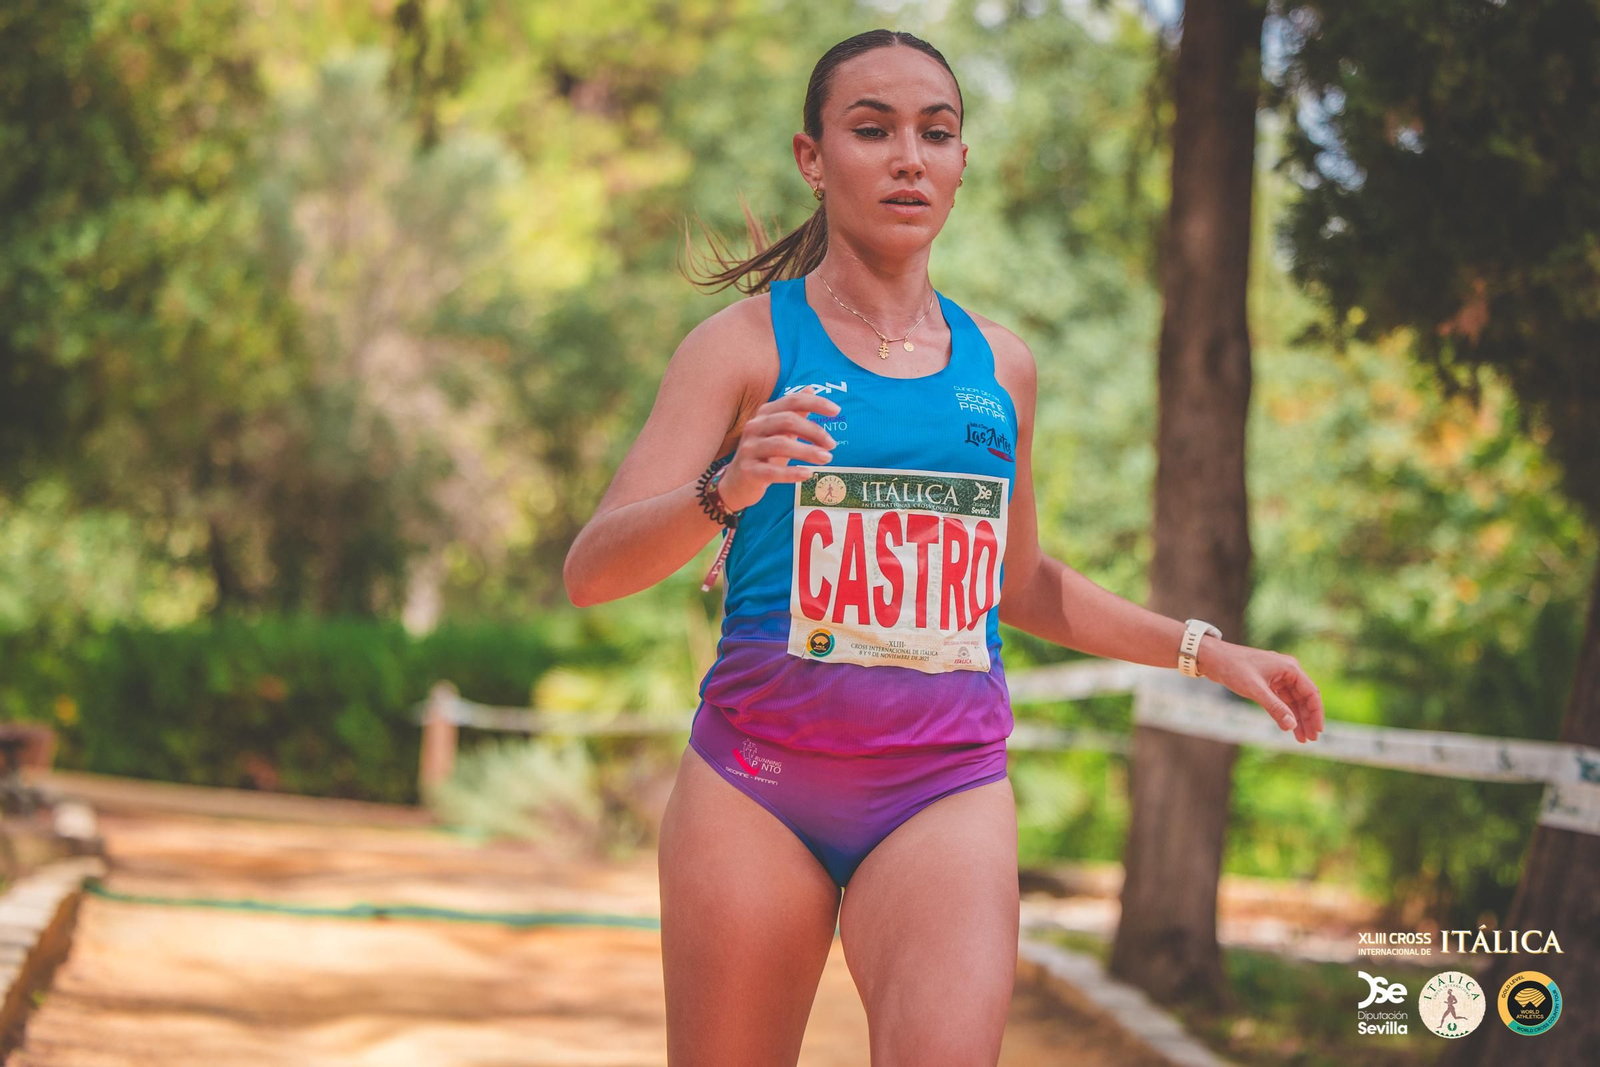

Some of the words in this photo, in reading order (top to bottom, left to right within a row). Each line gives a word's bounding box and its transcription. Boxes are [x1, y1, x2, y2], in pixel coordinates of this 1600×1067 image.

[956, 392, 1005, 415] SEOANE
[862, 477, 960, 506] ITÁLICA
[971, 507, 990, 515] Sevilla
[798, 509, 998, 632] CASTRO
[868, 645, 911, 654] INTERNACIONAL
[755, 756, 782, 767] RUNNING
